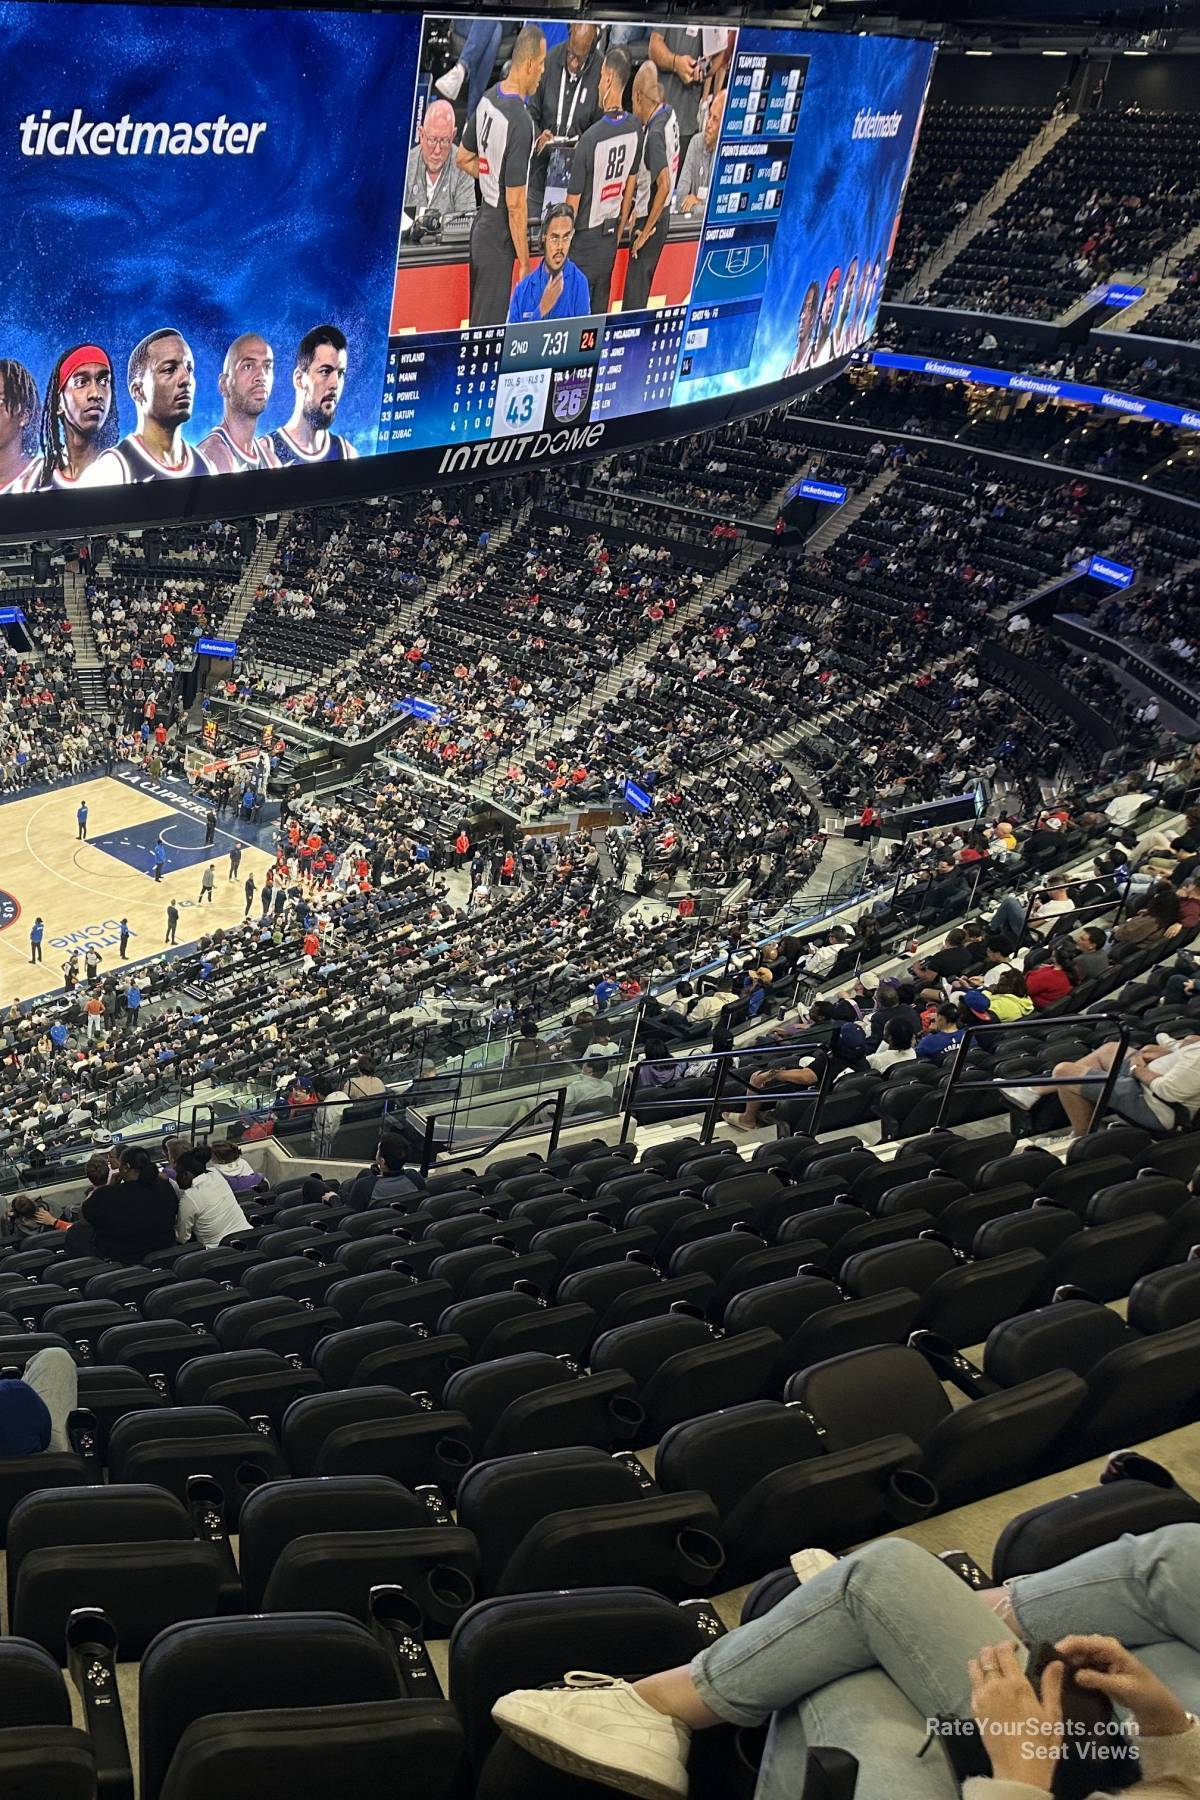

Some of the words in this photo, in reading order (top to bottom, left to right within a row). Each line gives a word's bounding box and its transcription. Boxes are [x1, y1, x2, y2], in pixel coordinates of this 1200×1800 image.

[20, 109, 266, 156] ticketmaster
[852, 107, 902, 139] ticketmaster
[605, 144, 626, 180] 82
[510, 340, 528, 357] 2ND
[542, 331, 569, 356] 7:31
[581, 333, 594, 349] 24
[925, 361, 972, 378] ticketmaster
[1009, 377, 1060, 394] ticketmaster
[506, 394, 533, 423] 43
[555, 388, 581, 417] 26
[1102, 394, 1146, 412] ticketmaster
[438, 436, 534, 473] INTUIT
[530, 423, 605, 458] DOME
[802, 486, 843, 498] ticketmaster
[118, 772, 136, 784] LA
[140, 782, 217, 818] CLIPPERS
[2, 901, 14, 919] LOS
